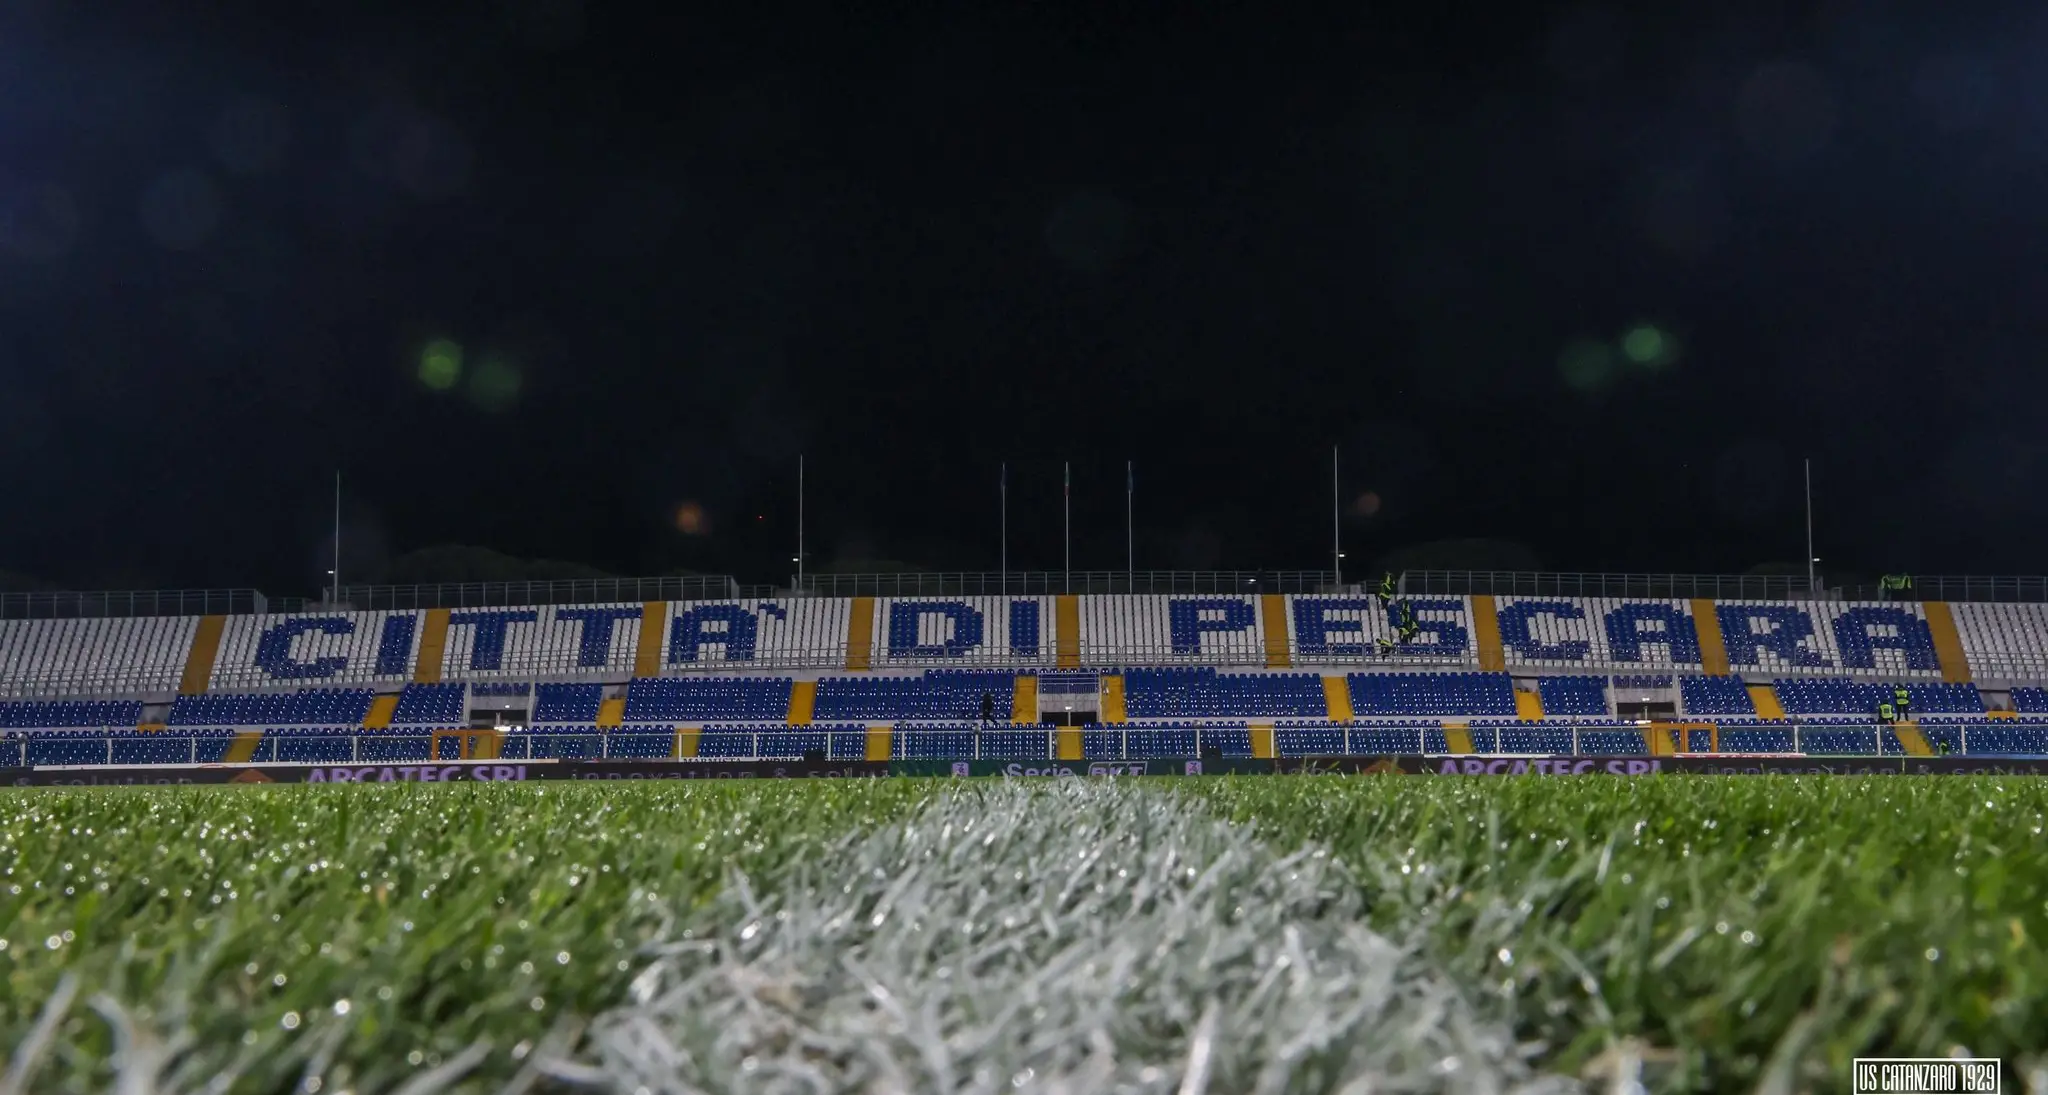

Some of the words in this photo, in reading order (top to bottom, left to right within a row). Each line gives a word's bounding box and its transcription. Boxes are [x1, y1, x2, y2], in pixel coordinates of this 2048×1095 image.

[889, 600, 1039, 660] DI
[1169, 599, 1941, 671] PESCARA
[309, 767, 461, 783] ARCATEC
[1007, 763, 1074, 776] Serie
[1440, 760, 1595, 775] ARCATEC
